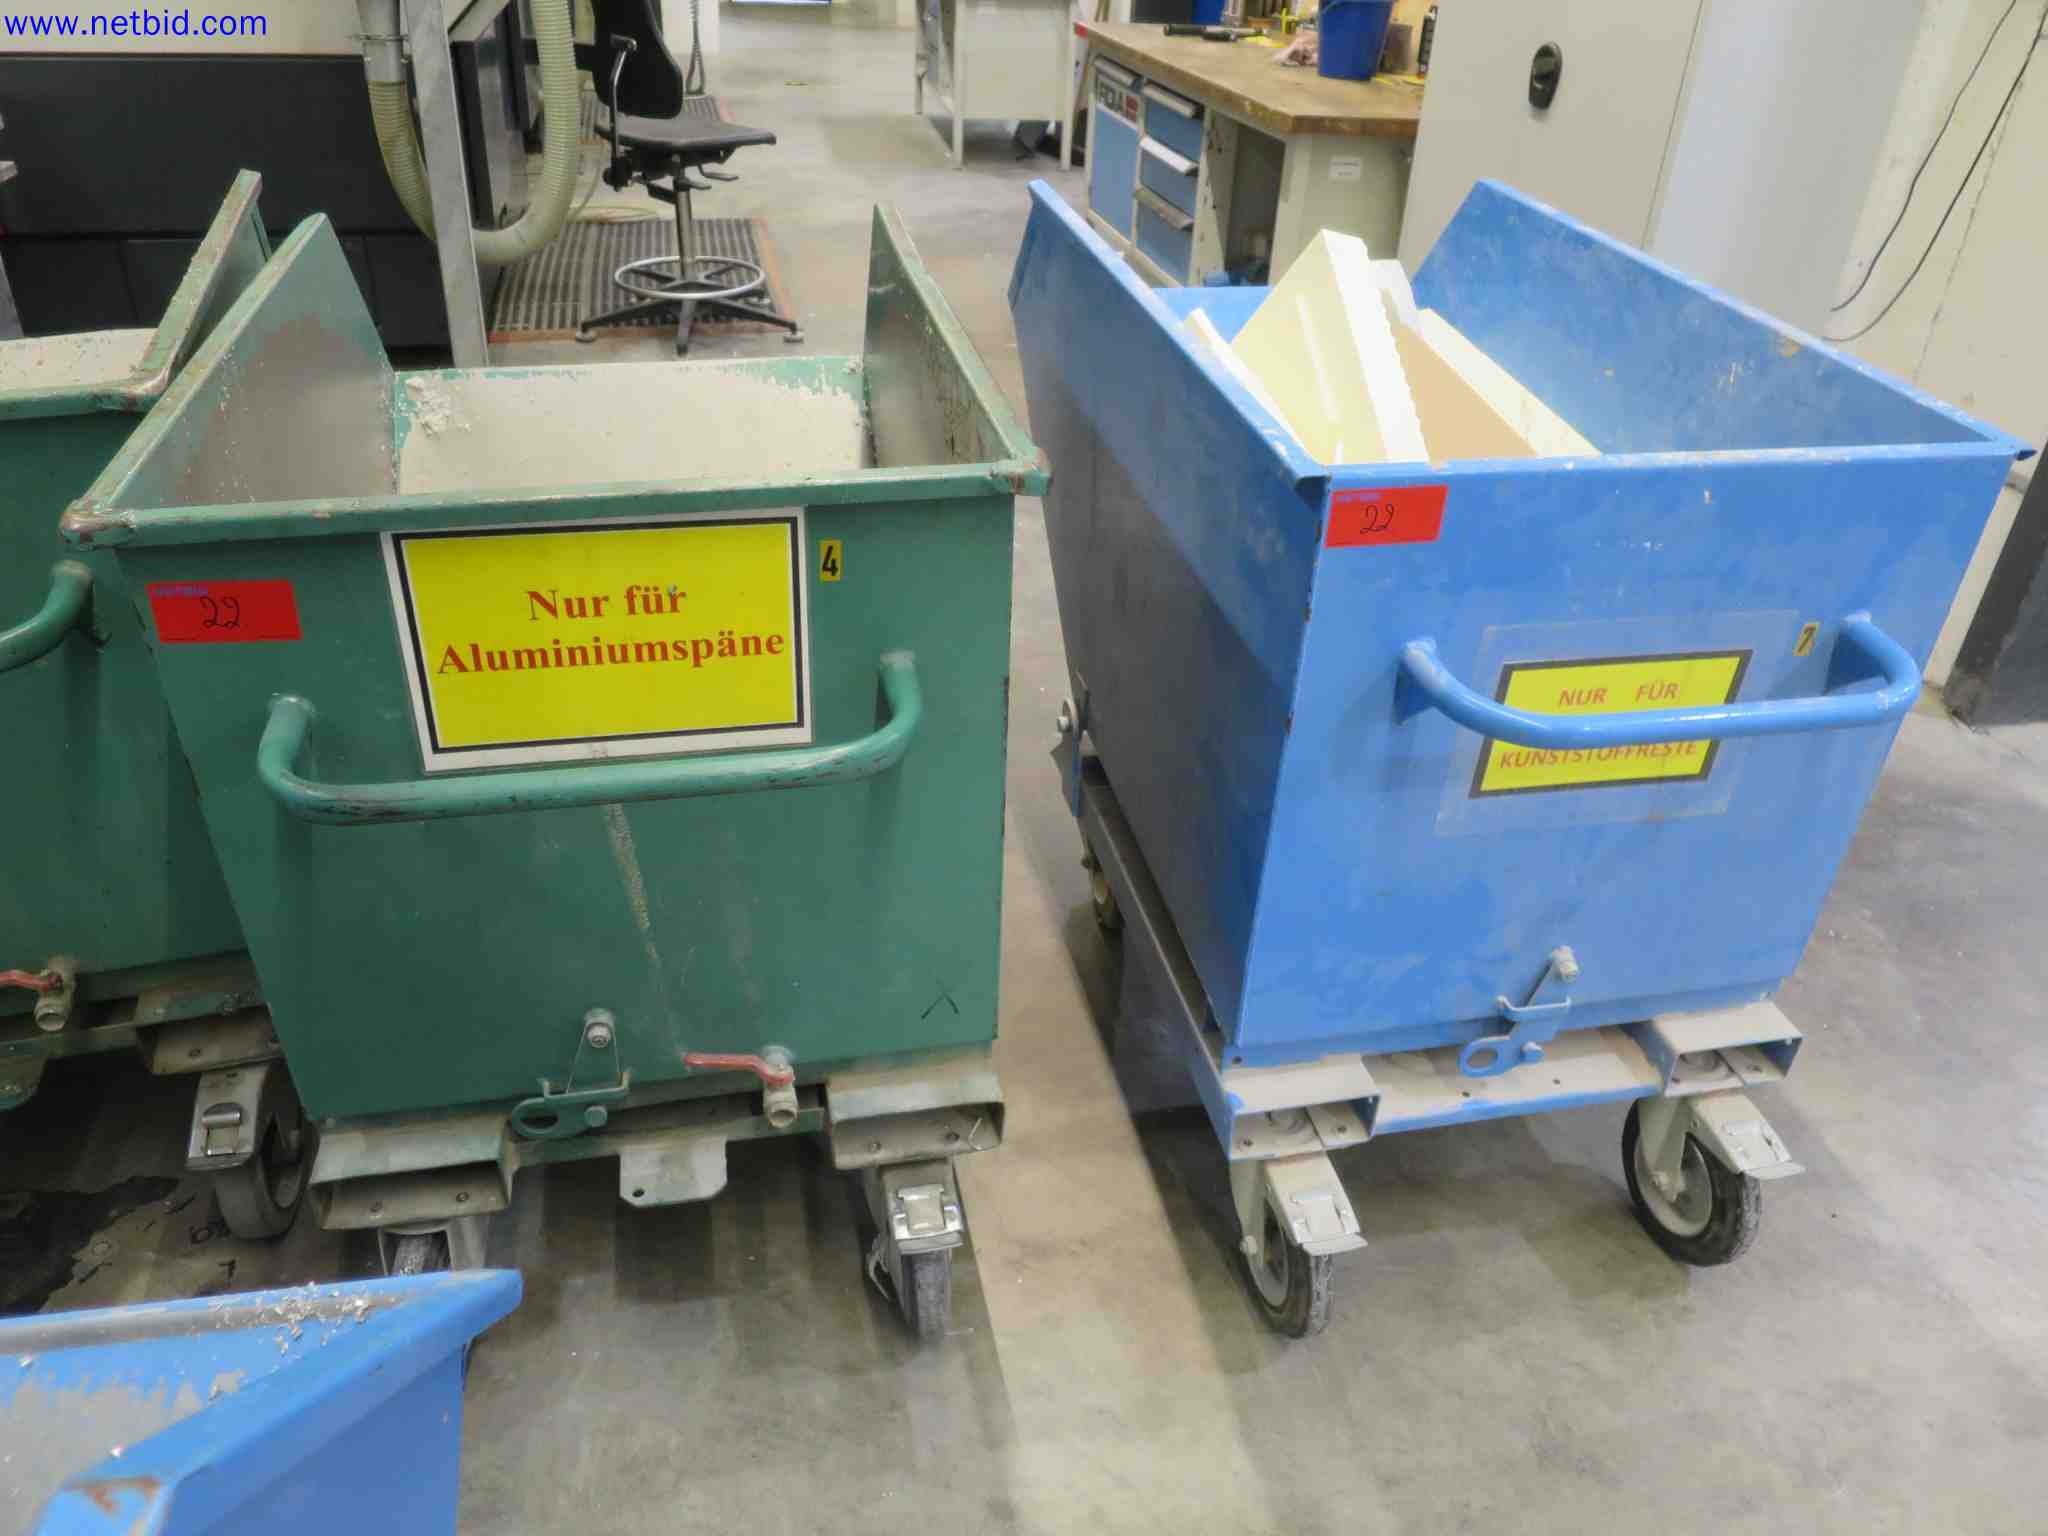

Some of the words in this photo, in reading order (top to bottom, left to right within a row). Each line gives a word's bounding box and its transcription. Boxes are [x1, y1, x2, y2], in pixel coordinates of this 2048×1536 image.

[1360, 503, 1395, 535] 22
[821, 544, 839, 577] 4
[199, 596, 241, 629] 22
[526, 588, 609, 621] Nur
[624, 584, 687, 616] für
[438, 630, 785, 674] Aluminiumspäne
[1558, 687, 1608, 707] NUR
[1635, 679, 1679, 702] FÜR
